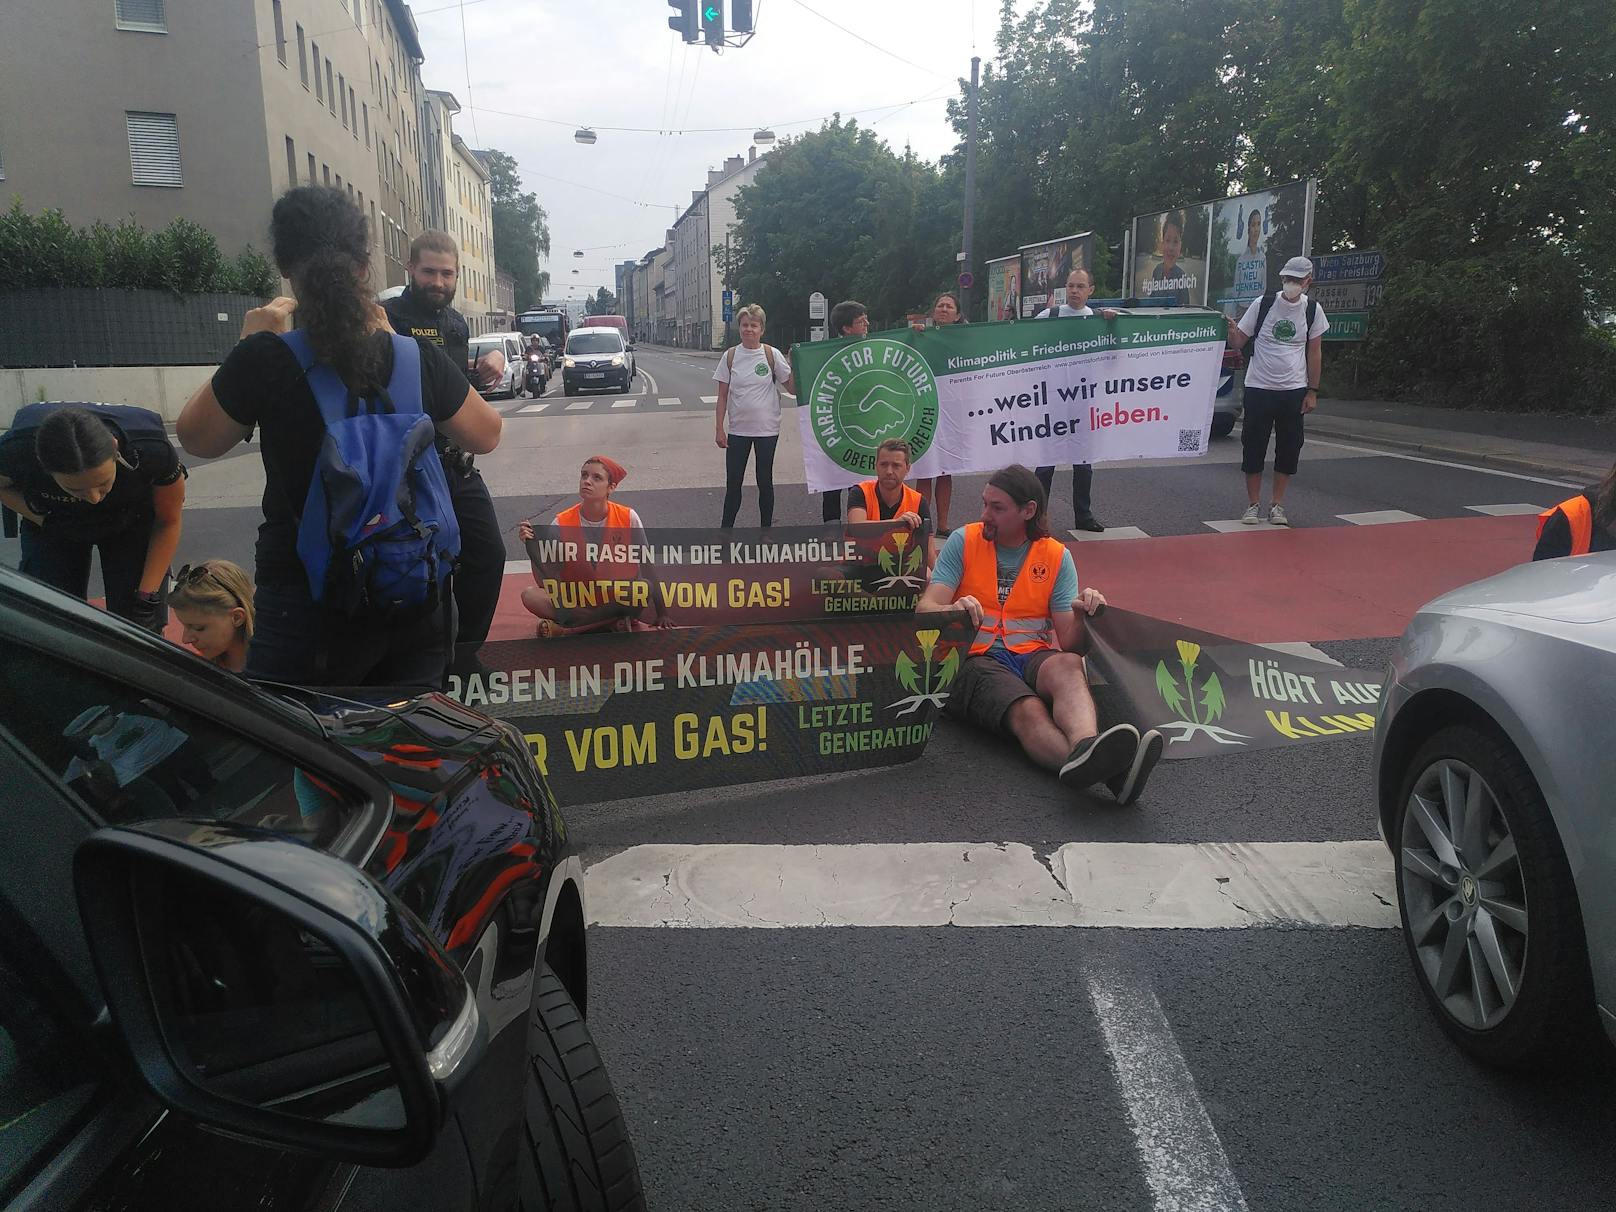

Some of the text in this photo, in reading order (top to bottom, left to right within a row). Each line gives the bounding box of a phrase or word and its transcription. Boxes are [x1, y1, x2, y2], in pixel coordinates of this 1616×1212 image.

[1238, 260, 1265, 271] PLASTIK
[1342, 254, 1380, 266] Salzburg
[1142, 274, 1197, 295] #glaubandich
[1243, 271, 1258, 281] NEU
[1318, 269, 1337, 279] Prag
[1315, 287, 1348, 297] Passau
[411, 328, 438, 336] POLIZEI
[947, 348, 1017, 369] Klimapolitik
[1033, 334, 1117, 356] Friedenspolitik
[1132, 326, 1217, 343] Zukunftspolitik
[949, 376, 972, 384] Parents
[986, 371, 1005, 379] Future
[1057, 377, 1098, 402] wir
[1105, 372, 1191, 395] unsere
[816, 347, 932, 448] PARENTS FOR FUTURE
[990, 402, 1169, 446] Kinder lieben.
[538, 538, 863, 565] WIR RASEN IN DIE KLIMAHÖLLE.
[543, 577, 790, 608] RUNTER VOM GAS!
[811, 579, 862, 595] LETZTE
[569, 664, 601, 697] IN
[614, 659, 665, 694] DIE
[677, 641, 873, 689] KLIMAHÖLLE.
[1249, 659, 1323, 705] HÖRT
[799, 702, 873, 729] LETZTE
[565, 722, 657, 772] VOM
[674, 705, 767, 760] GAS!
